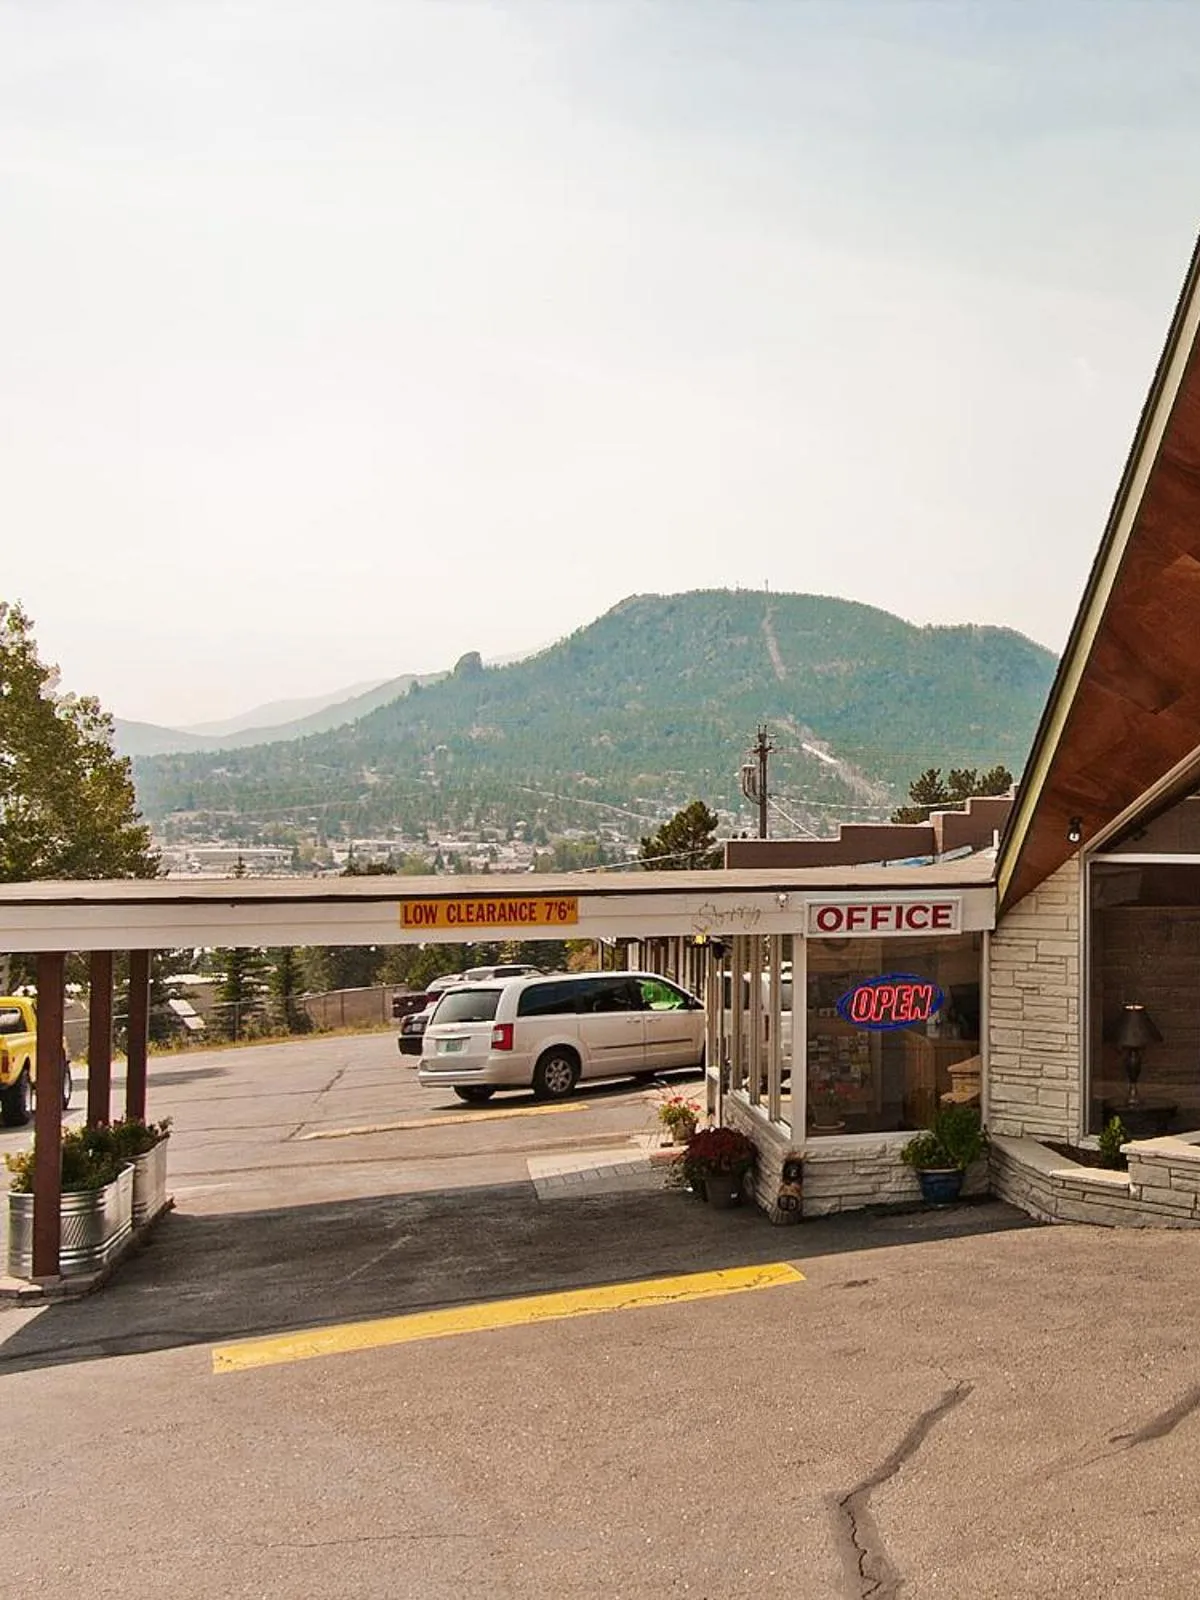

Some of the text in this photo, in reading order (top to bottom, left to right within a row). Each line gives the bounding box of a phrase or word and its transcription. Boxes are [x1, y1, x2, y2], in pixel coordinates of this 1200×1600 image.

[404, 904, 438, 924] LOW
[446, 902, 537, 923] CLEARANCE
[816, 905, 952, 931] OFFICE
[851, 984, 932, 1022] OPEN
